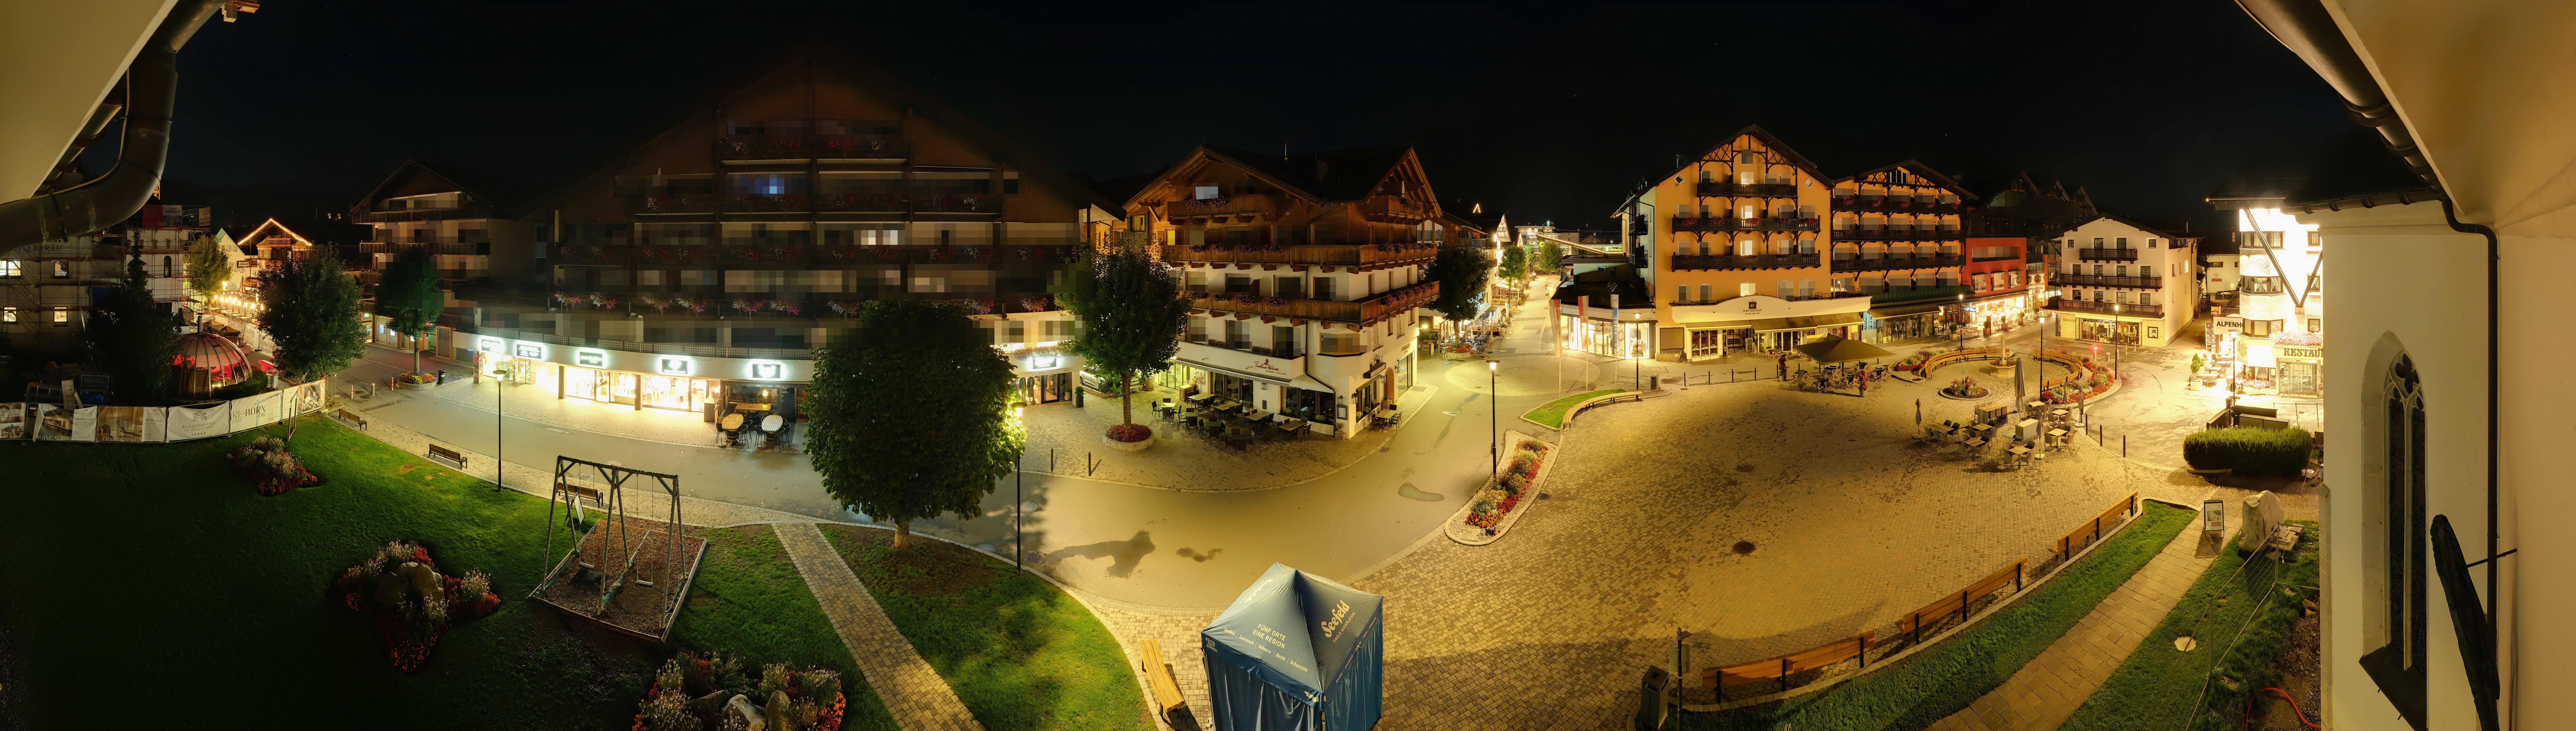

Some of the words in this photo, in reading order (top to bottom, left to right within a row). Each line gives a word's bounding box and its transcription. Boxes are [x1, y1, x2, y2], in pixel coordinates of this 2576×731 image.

[1371, 364, 1386, 377] RESTAURANT
[1321, 599, 1350, 638] Seefeld
[1333, 632, 1342, 643] TIROLS
[1341, 611, 1356, 632] HOCHPLATEAU
[1205, 637, 1215, 645] #tirols
[1252, 629, 1265, 639] EINE
[1265, 635, 1285, 649] REGION
[1258, 623, 1272, 633] FÜNF
[1272, 630, 1286, 641] ORTE
[1206, 644, 1218, 652] plateau
[1224, 627, 1235, 636] Seefeld
[1239, 635, 1254, 645] Leutasch
[1258, 644, 1272, 654] Mösern
[1275, 653, 1286, 661] Reith
[1290, 660, 1308, 672] Scharnitz
